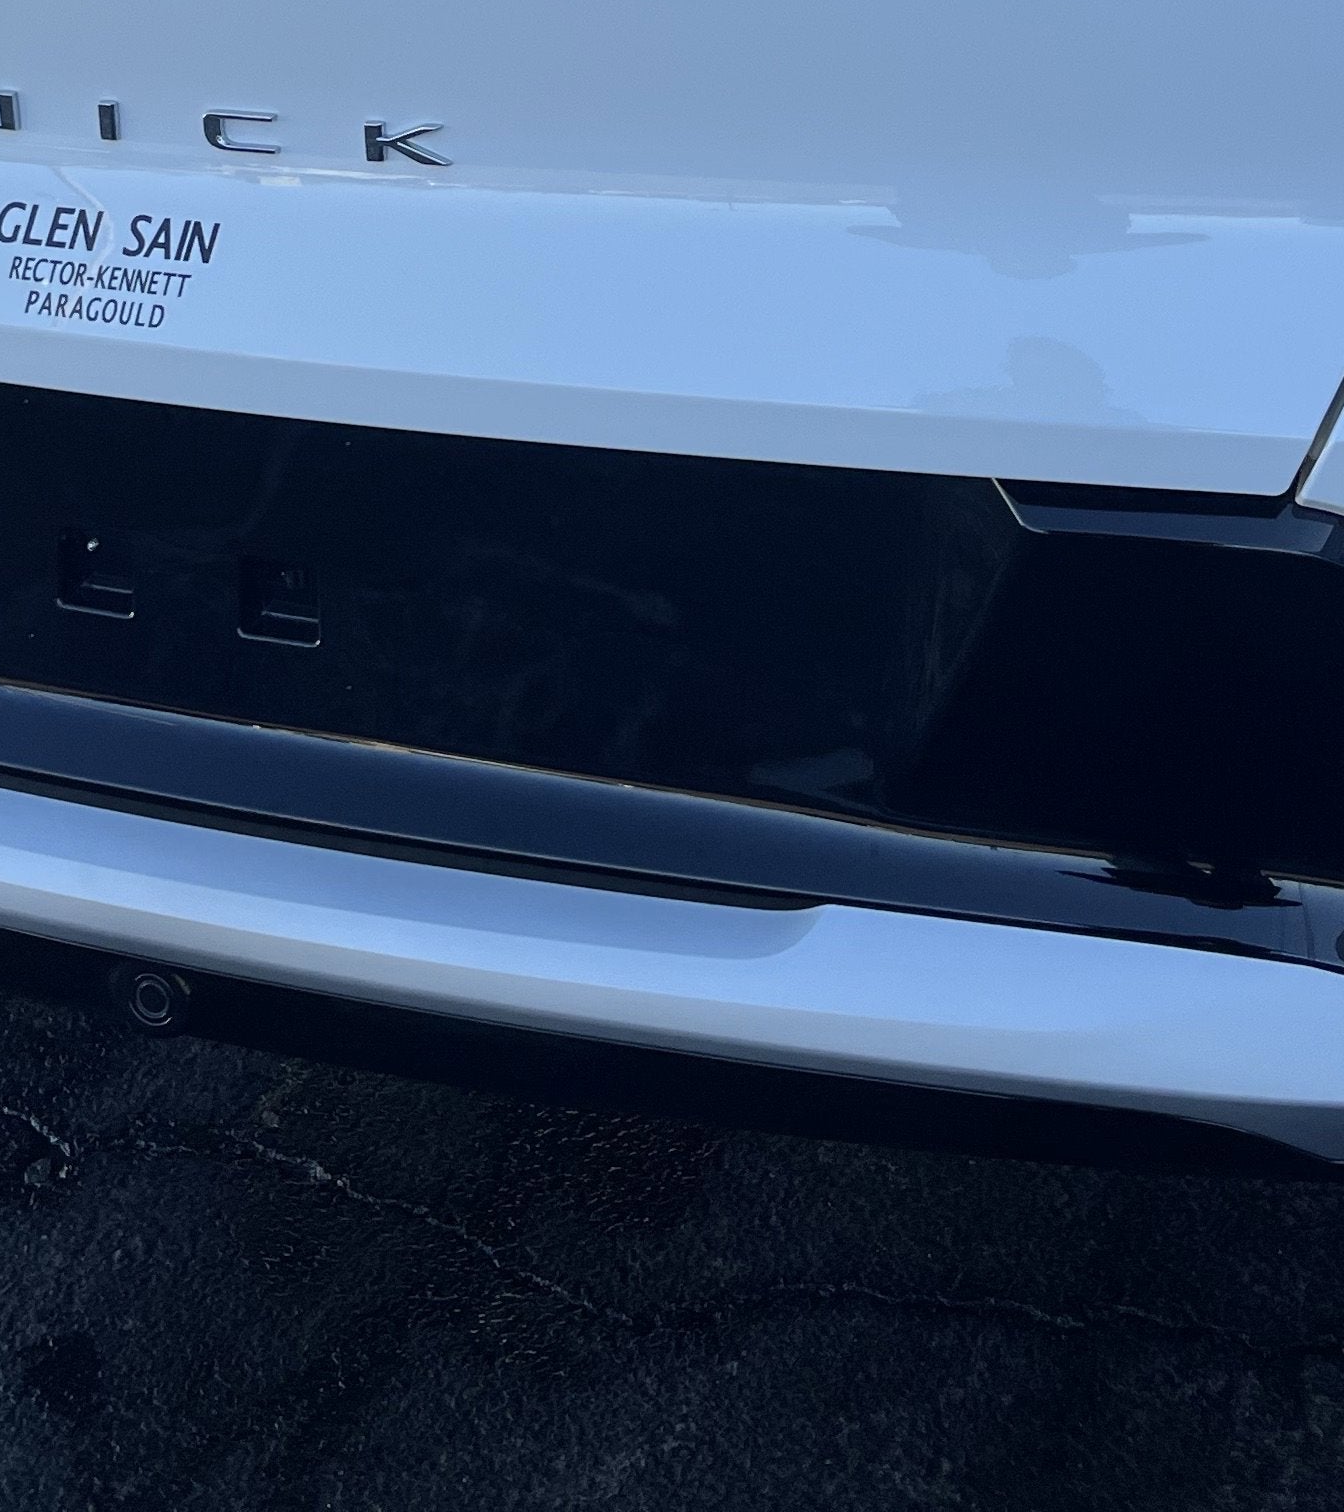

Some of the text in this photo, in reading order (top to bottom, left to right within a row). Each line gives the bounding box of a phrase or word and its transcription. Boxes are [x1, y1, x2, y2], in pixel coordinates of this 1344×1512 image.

[122, 214, 221, 264] SAIN
[8, 256, 192, 298] RECTOR-KENNETT
[24, 290, 165, 329] PARAGOULD
